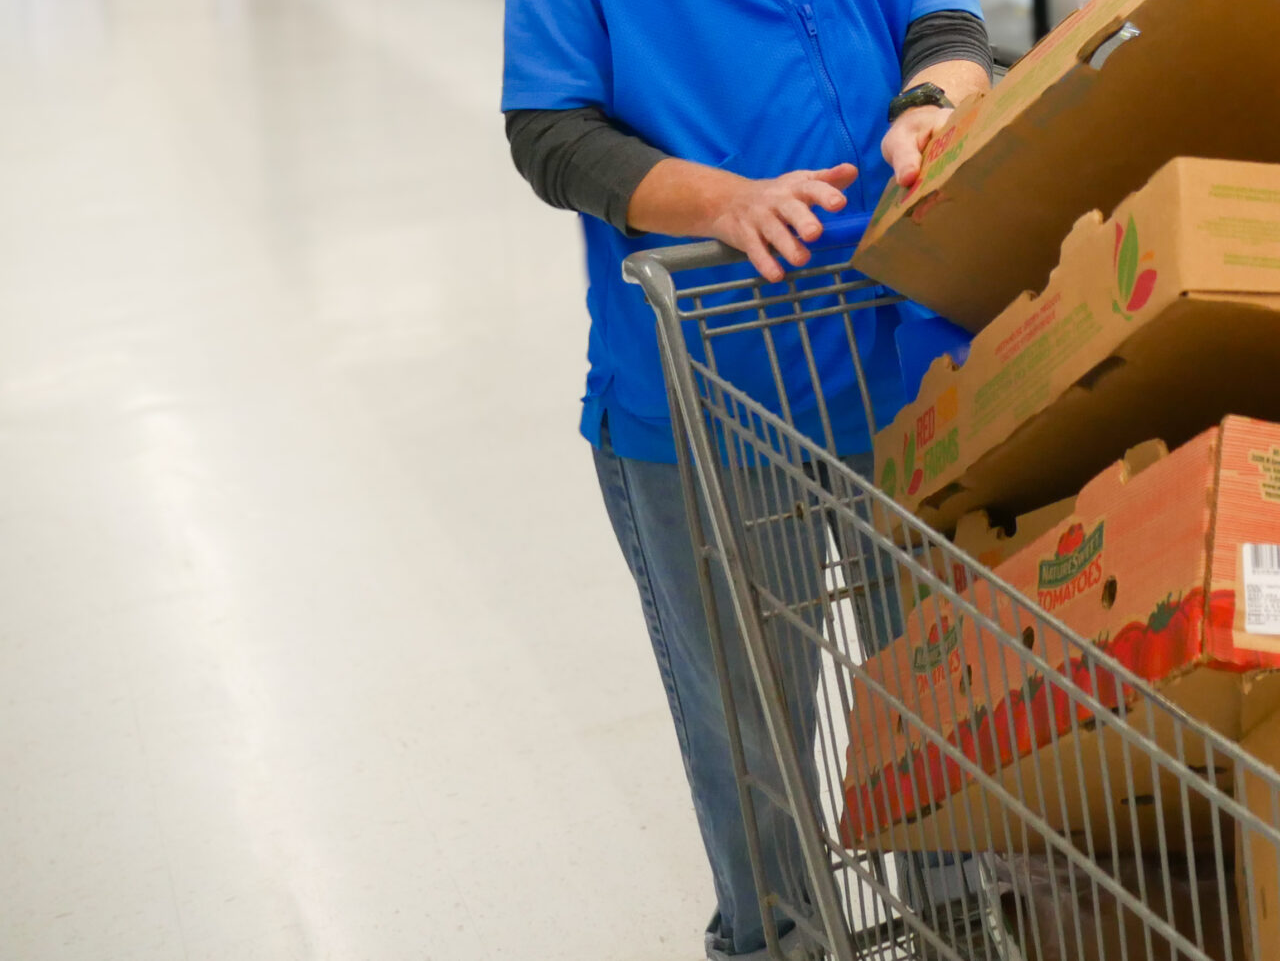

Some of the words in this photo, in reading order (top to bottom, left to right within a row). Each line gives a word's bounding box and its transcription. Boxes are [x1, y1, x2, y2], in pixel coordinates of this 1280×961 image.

[916, 406, 935, 450] RED
[924, 427, 959, 483] FARMS
[1038, 553, 1102, 612] TOMATOES
